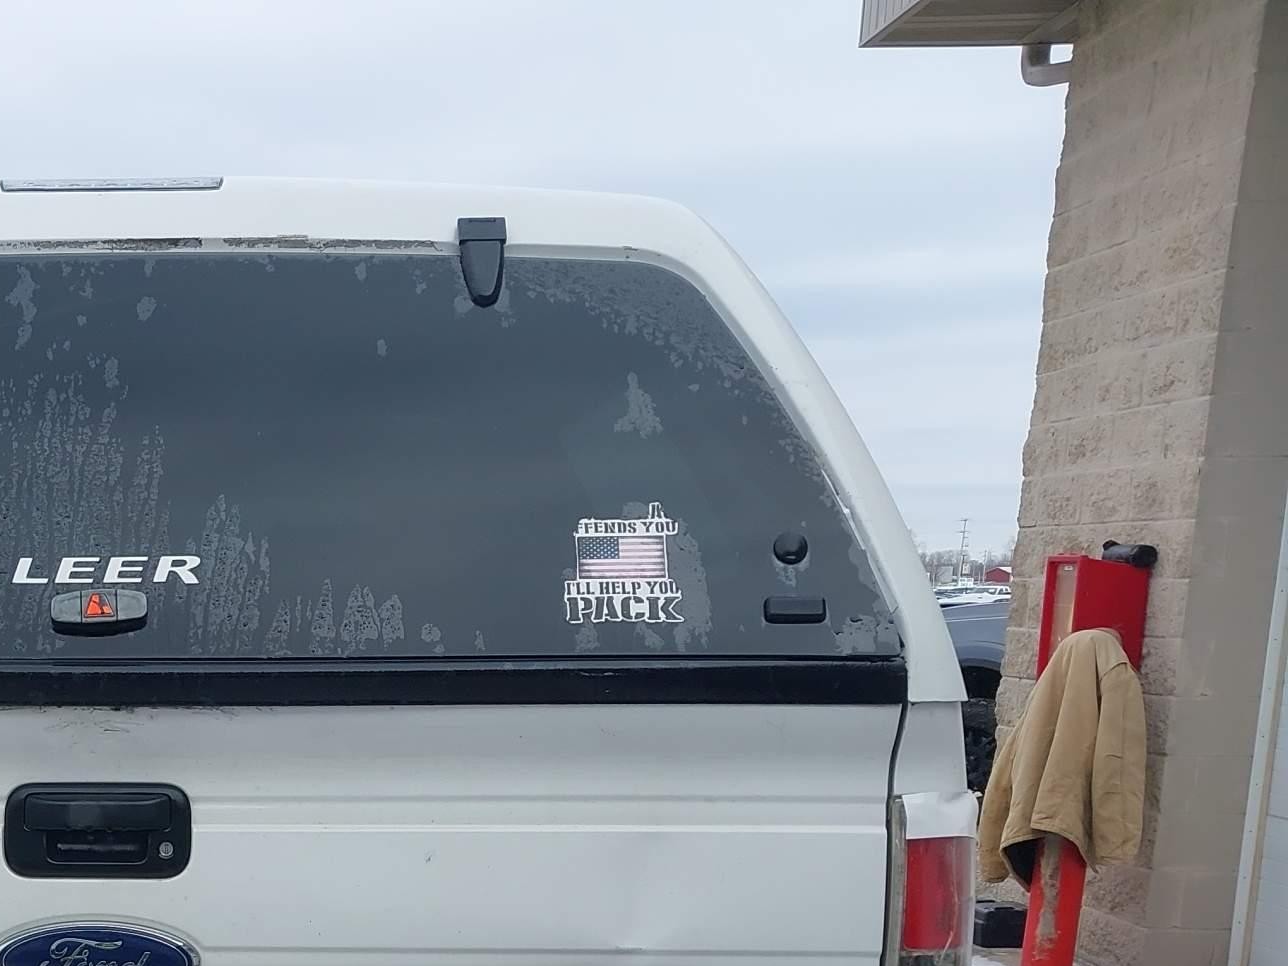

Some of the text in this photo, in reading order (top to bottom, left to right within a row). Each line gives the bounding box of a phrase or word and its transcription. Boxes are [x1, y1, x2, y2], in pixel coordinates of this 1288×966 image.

[641, 520, 678, 534] YOU
[12, 555, 201, 584] LEER
[566, 580, 681, 596] I'LL HELP YOU
[567, 595, 684, 622] PACK
